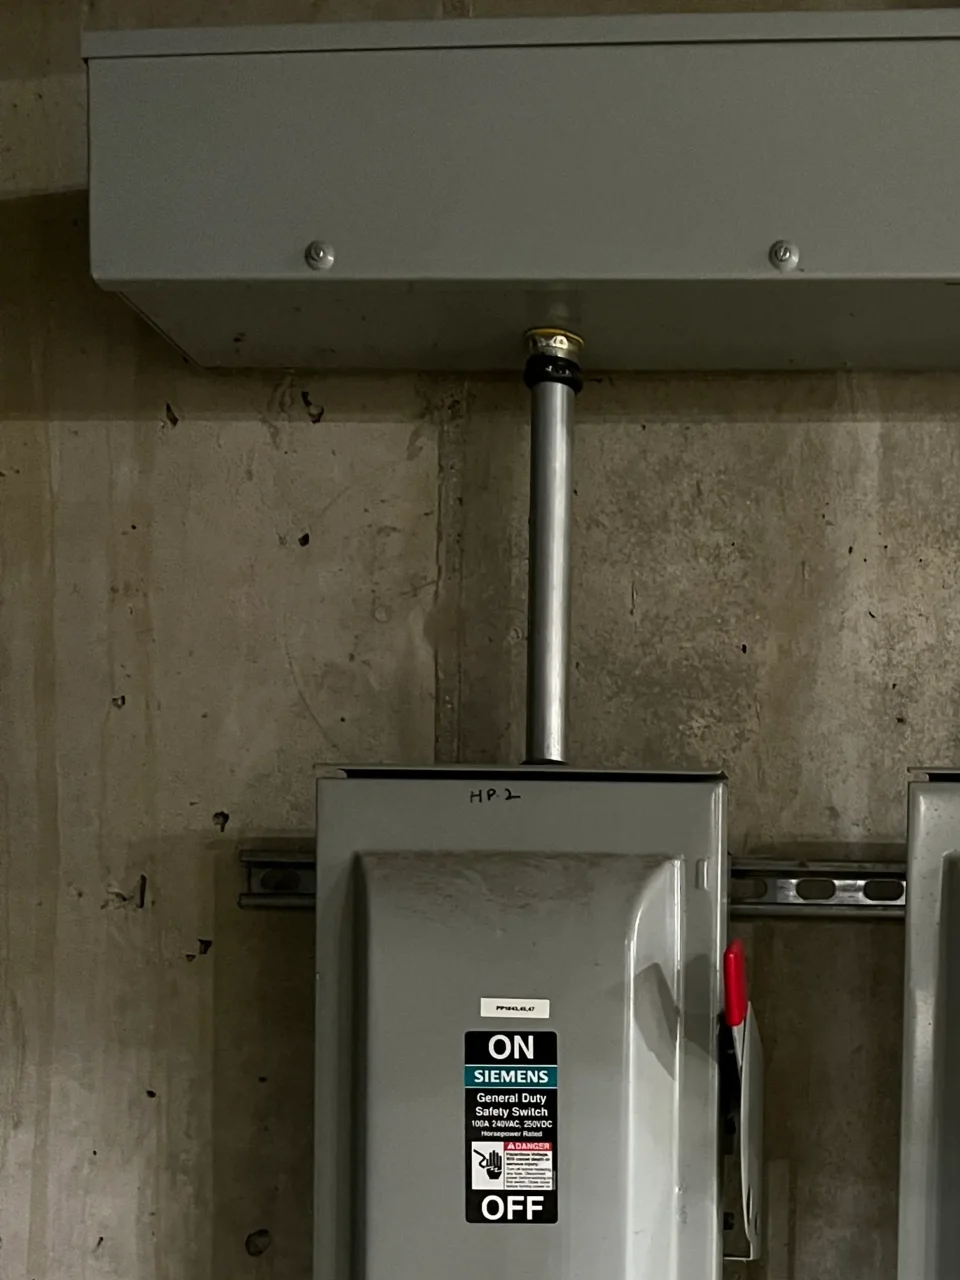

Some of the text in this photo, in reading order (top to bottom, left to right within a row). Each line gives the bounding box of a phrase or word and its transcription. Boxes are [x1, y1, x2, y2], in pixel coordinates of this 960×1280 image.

[488, 1034, 534, 1059] ON
[474, 1070, 549, 1083] SIEMENS
[476, 1092, 547, 1105] General Duty
[475, 1106, 548, 1119] Safety Switch
[471, 1120, 553, 1129] 100A 240VAC, 250VDC
[481, 1130, 521, 1138] Horsepower
[515, 1142, 550, 1150] DANGER
[481, 1194, 544, 1221] OFF
